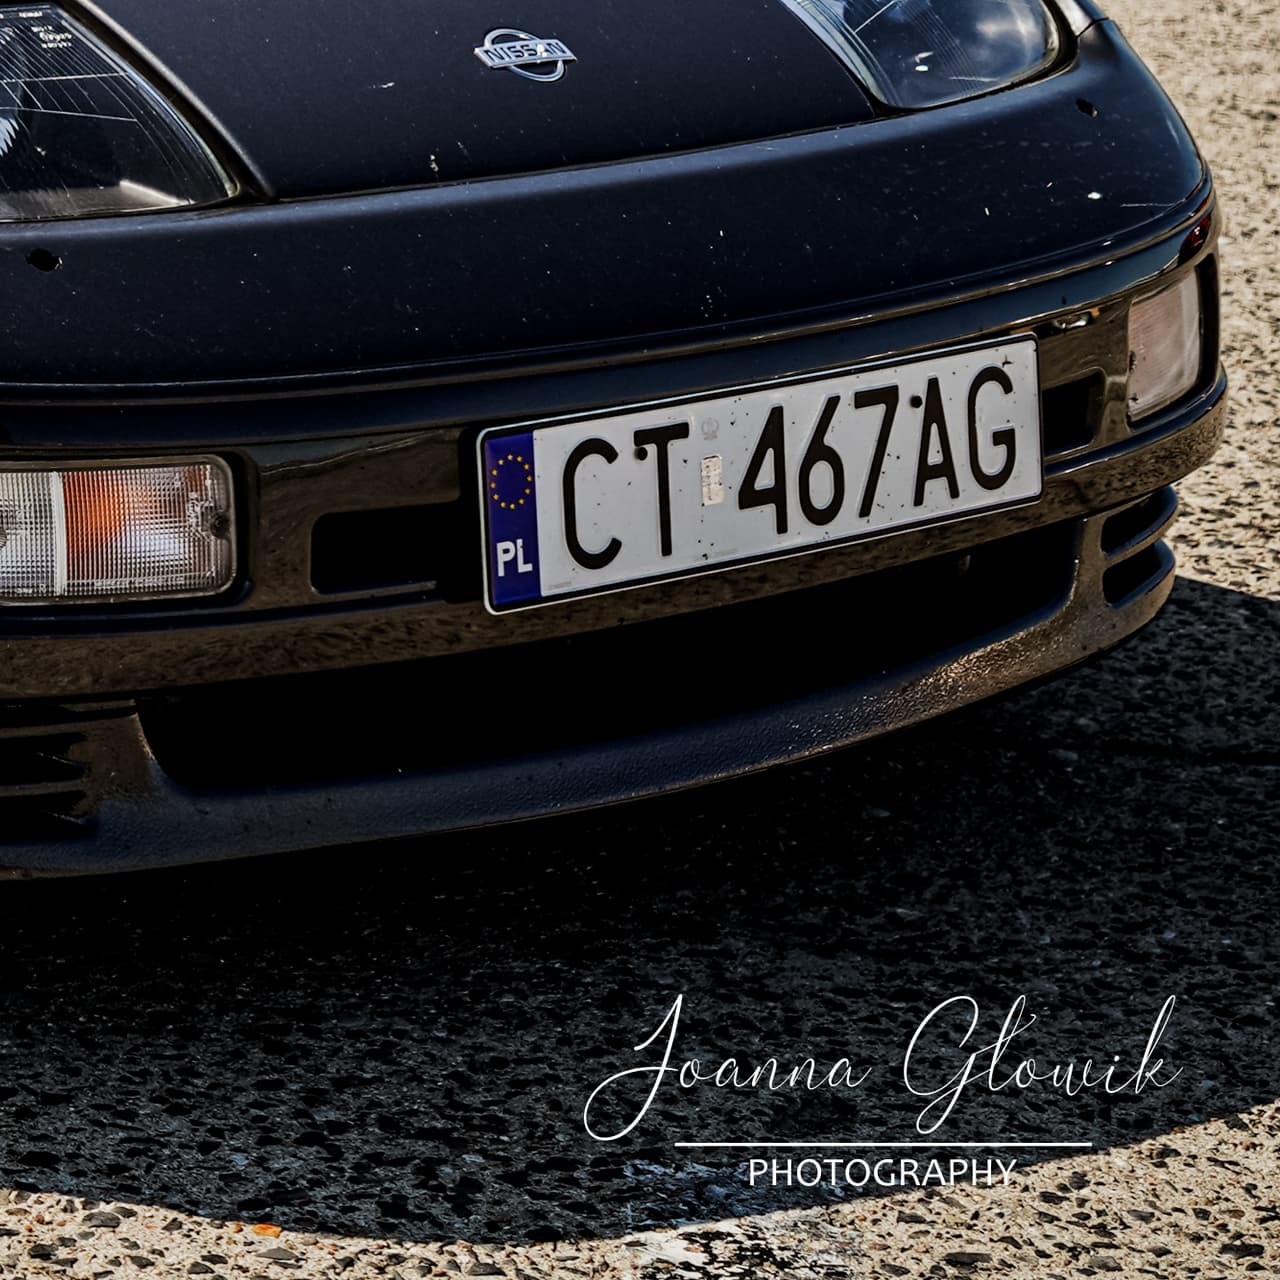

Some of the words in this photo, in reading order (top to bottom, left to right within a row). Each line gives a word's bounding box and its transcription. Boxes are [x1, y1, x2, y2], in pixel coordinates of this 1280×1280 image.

[562, 421, 690, 570] CT
[738, 366, 1017, 535] 467AG
[496, 538, 533, 577] PL
